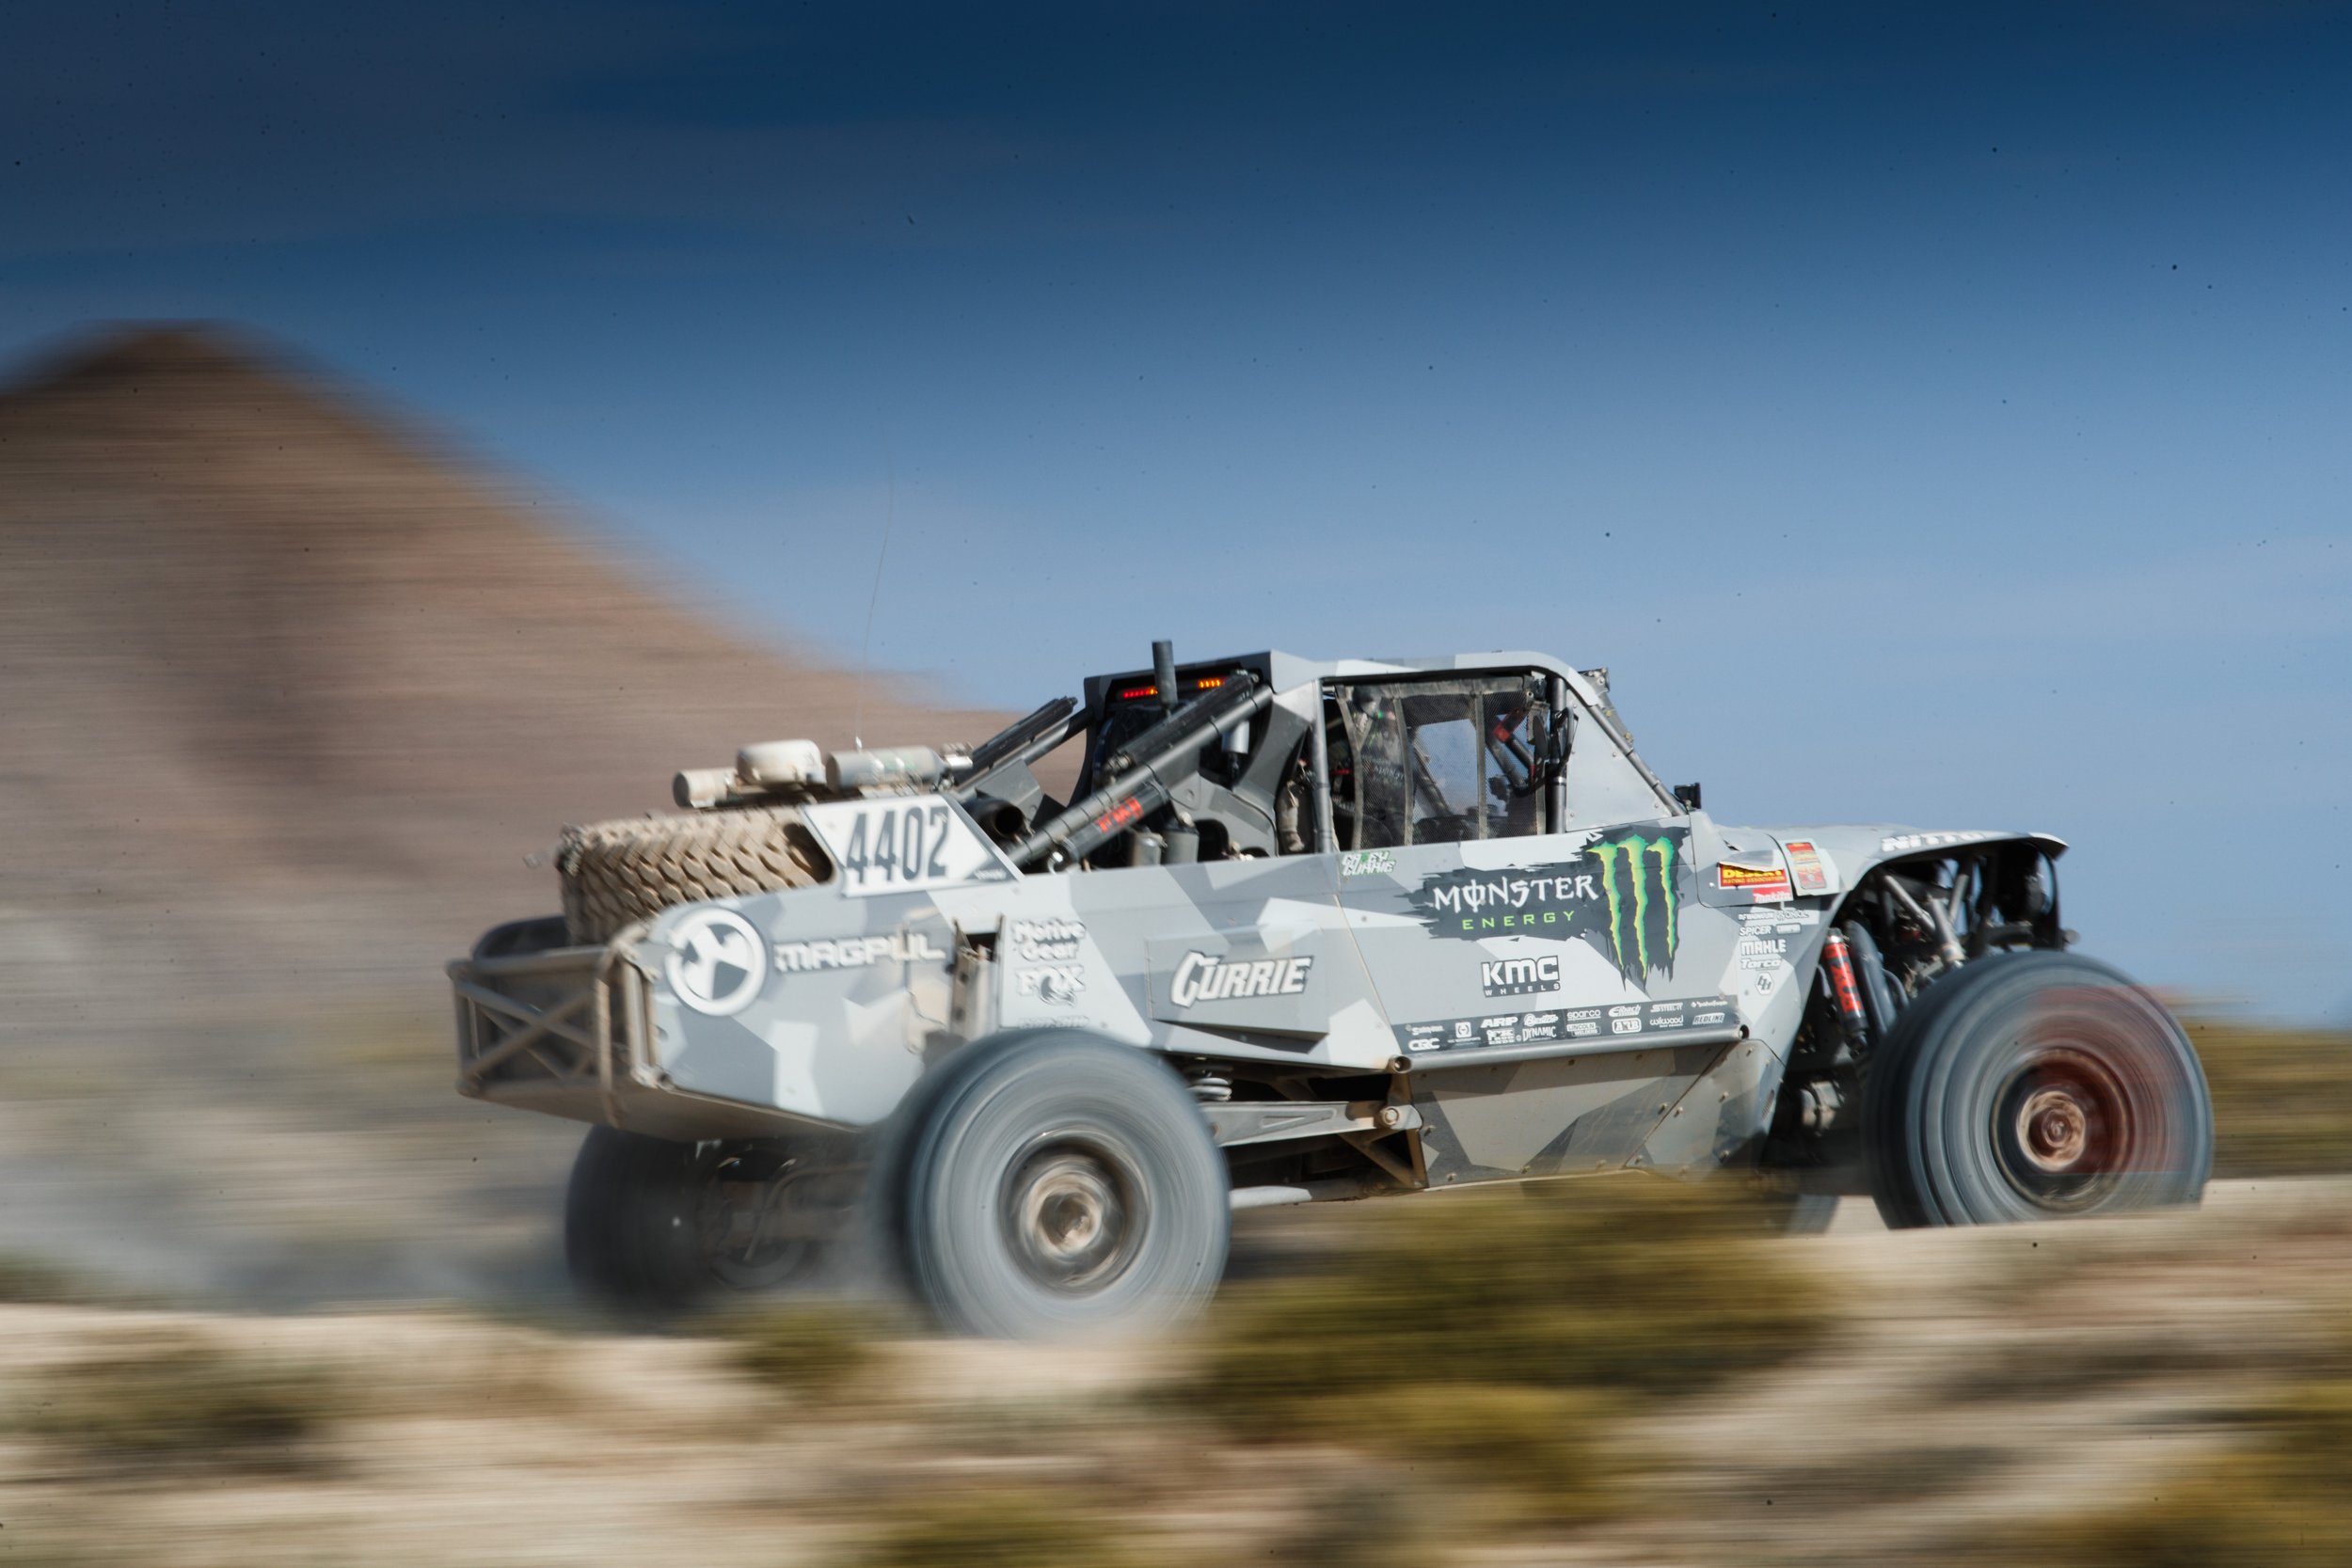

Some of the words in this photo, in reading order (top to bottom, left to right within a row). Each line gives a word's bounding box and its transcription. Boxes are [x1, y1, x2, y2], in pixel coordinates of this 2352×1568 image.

[846, 805, 949, 884] 4402
[1433, 876, 1599, 913] MONSTER
[1462, 911, 1574, 930] ENERGY
[1740, 926, 1772, 936] SPICER
[773, 933, 946, 973] MAGPUL
[1740, 939, 1787, 956] MAHLE
[1171, 950, 1312, 1007] CURRIE
[1481, 956, 1560, 987] KMC
[1015, 964, 1086, 1004] FOX
[1484, 983, 1561, 997] WHEELS
[1480, 1016, 1518, 1028] ARP
[1566, 1009, 1601, 1020] sparco
[1522, 1026, 1557, 1042] DYNAMIC
